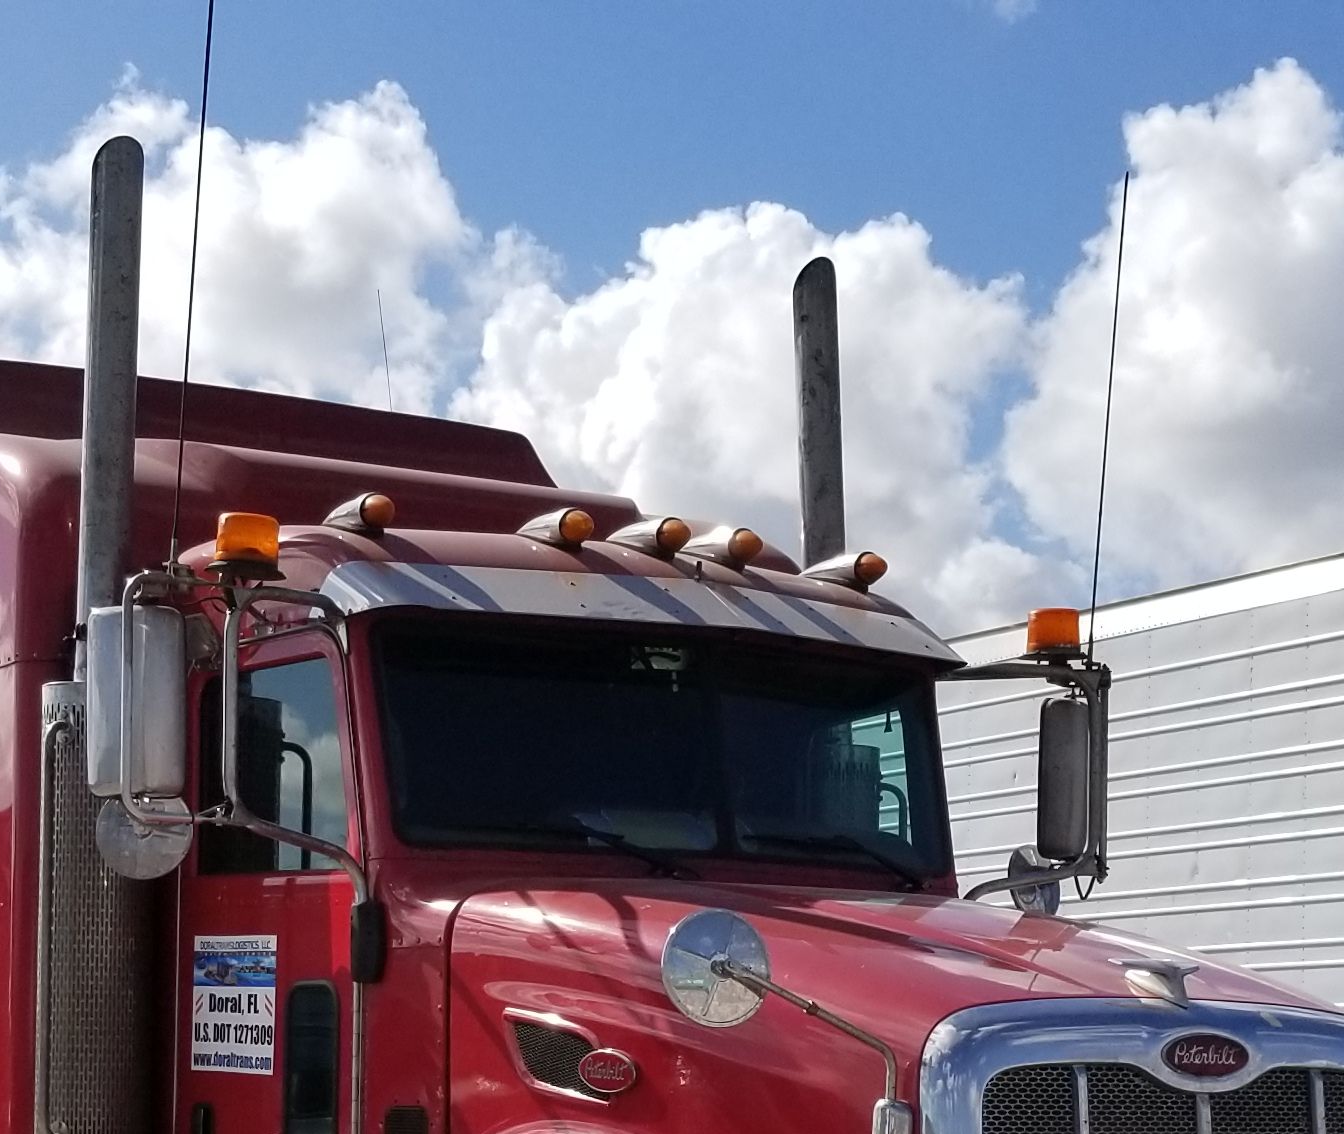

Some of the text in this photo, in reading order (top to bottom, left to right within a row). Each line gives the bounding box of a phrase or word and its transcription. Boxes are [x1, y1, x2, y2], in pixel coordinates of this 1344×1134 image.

[208, 992, 259, 1015] Doral, FL
[194, 1022, 273, 1045] U.S. DOT 1271309
[193, 1051, 272, 1071] www.doraltrans.com
[1174, 1040, 1240, 1065] Peterbilt
